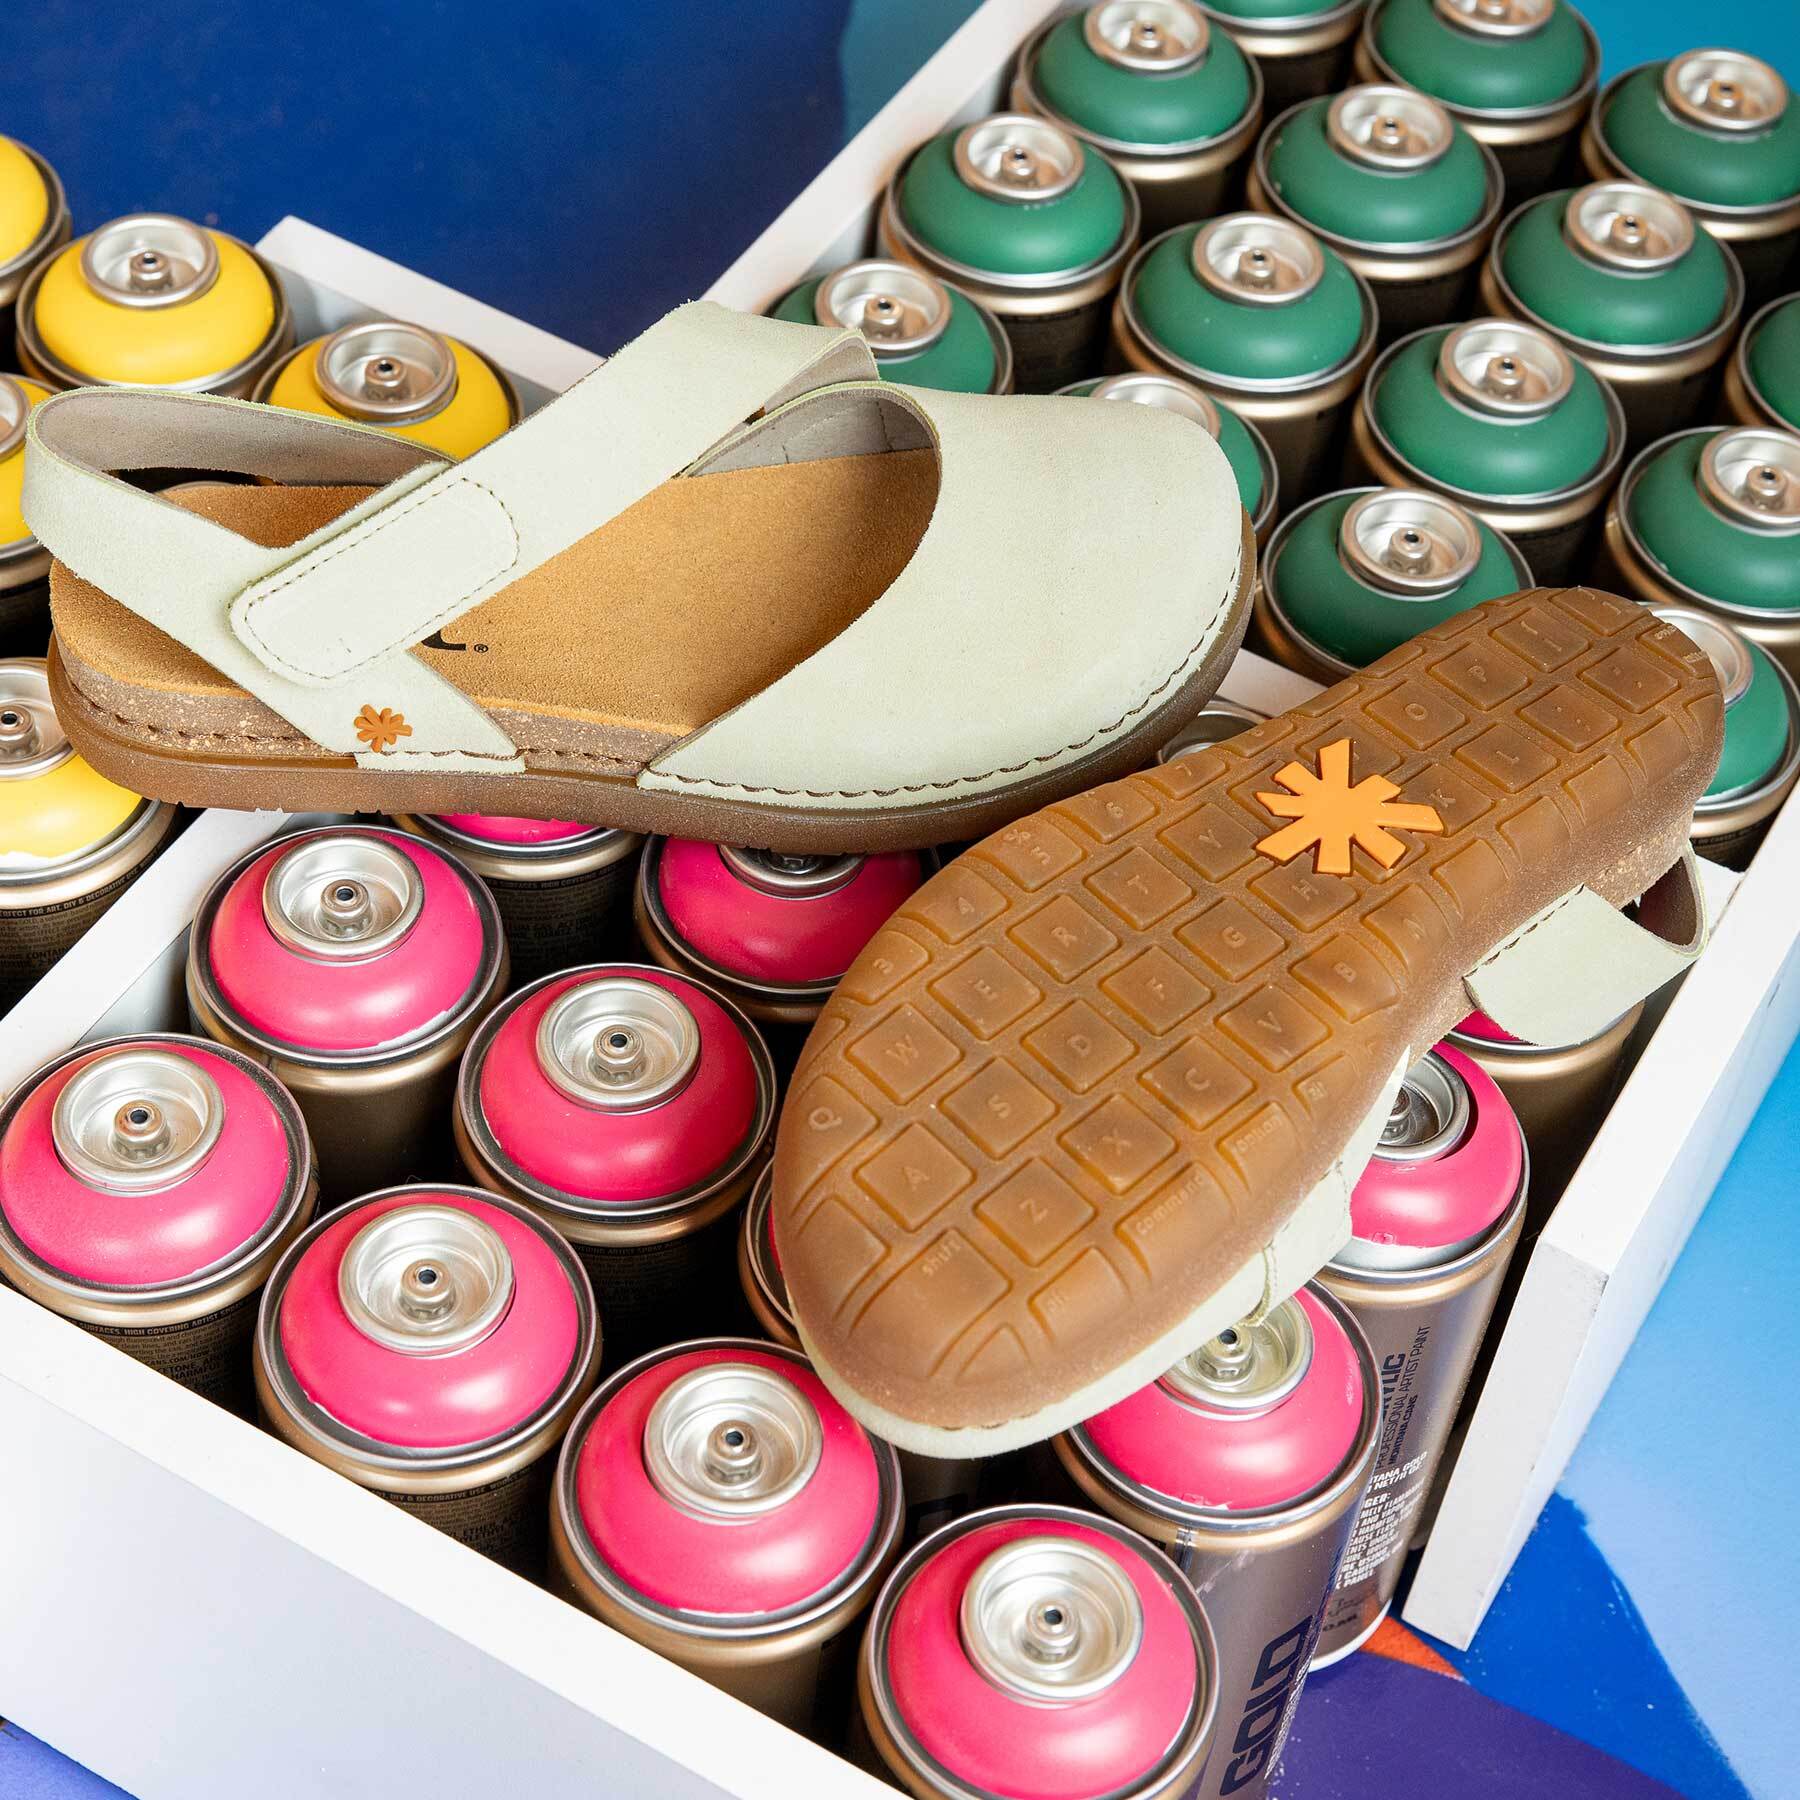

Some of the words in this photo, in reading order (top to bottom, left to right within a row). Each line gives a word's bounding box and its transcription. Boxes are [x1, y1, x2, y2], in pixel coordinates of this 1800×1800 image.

[63, 900, 77, 910] DIY
[808, 1101, 842, 1131] Q
[146, 1322, 189, 1336] COVERING
[191, 1312, 218, 1328] ARTIST
[1399, 1358, 1420, 1392] ARTIST
[1410, 1326, 1431, 1357] PAINT
[1219, 1613, 1313, 1797] GOLD
